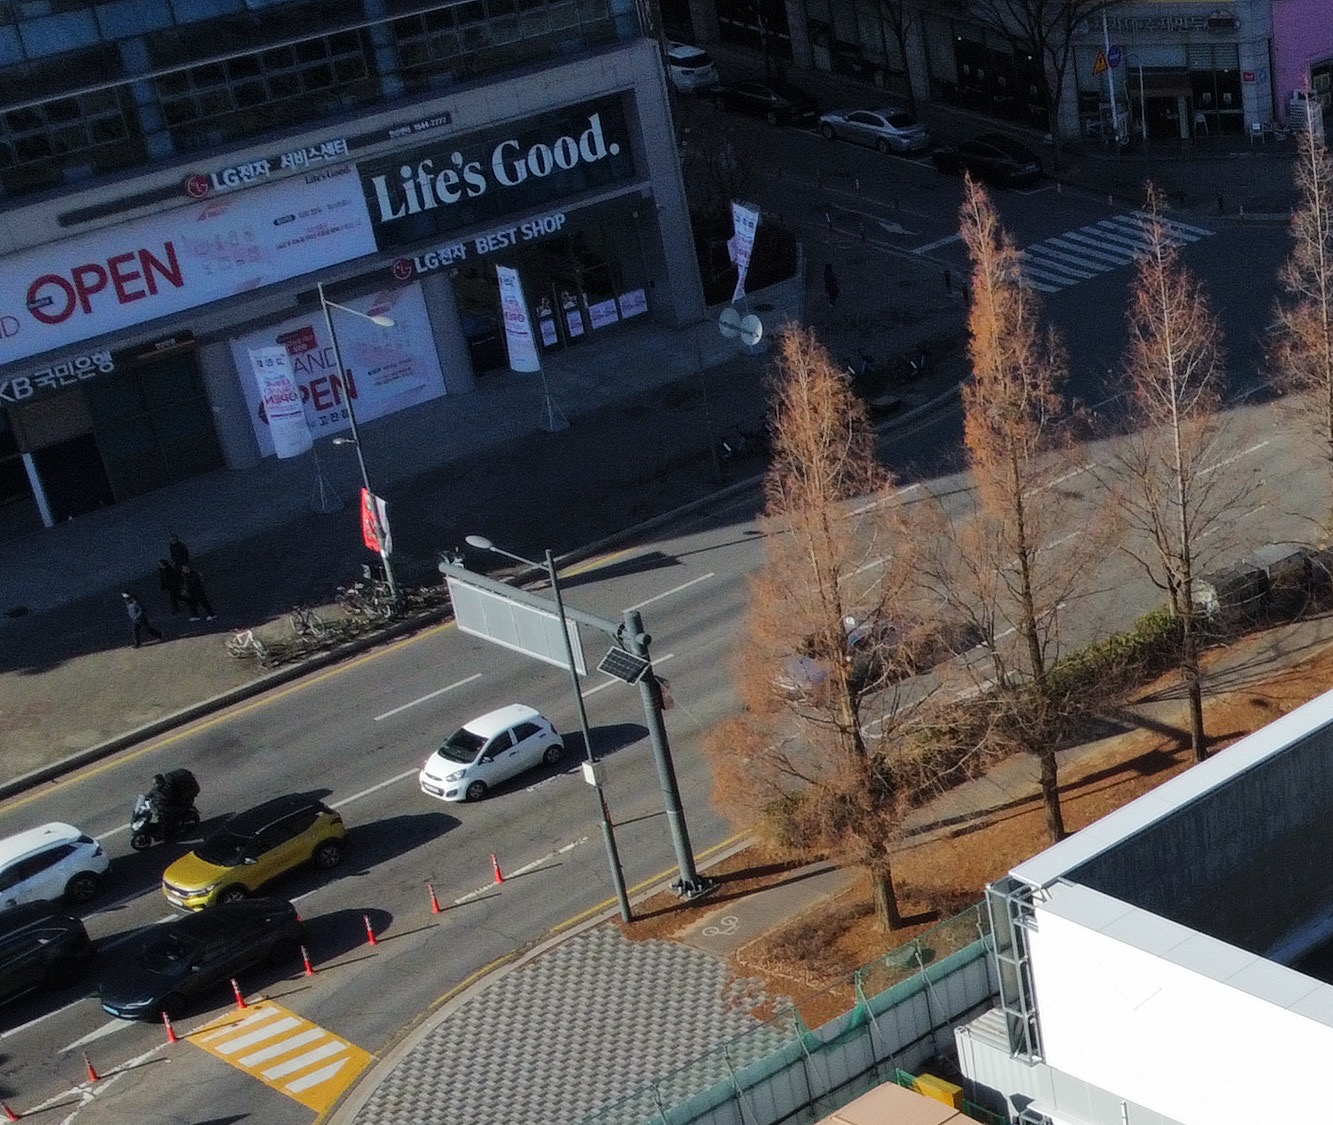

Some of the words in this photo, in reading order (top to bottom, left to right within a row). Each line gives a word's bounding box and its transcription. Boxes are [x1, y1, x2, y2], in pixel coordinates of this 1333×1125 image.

[210, 159, 271, 191] LG전자
[280, 138, 350, 173] 서비스센터
[371, 151, 487, 223] Life's
[492, 112, 621, 187] Good.
[414, 243, 467, 273] LG전자
[475, 228, 519, 255] BEST
[520, 213, 566, 241] SHOP
[26, 241, 184, 325] OPEN
